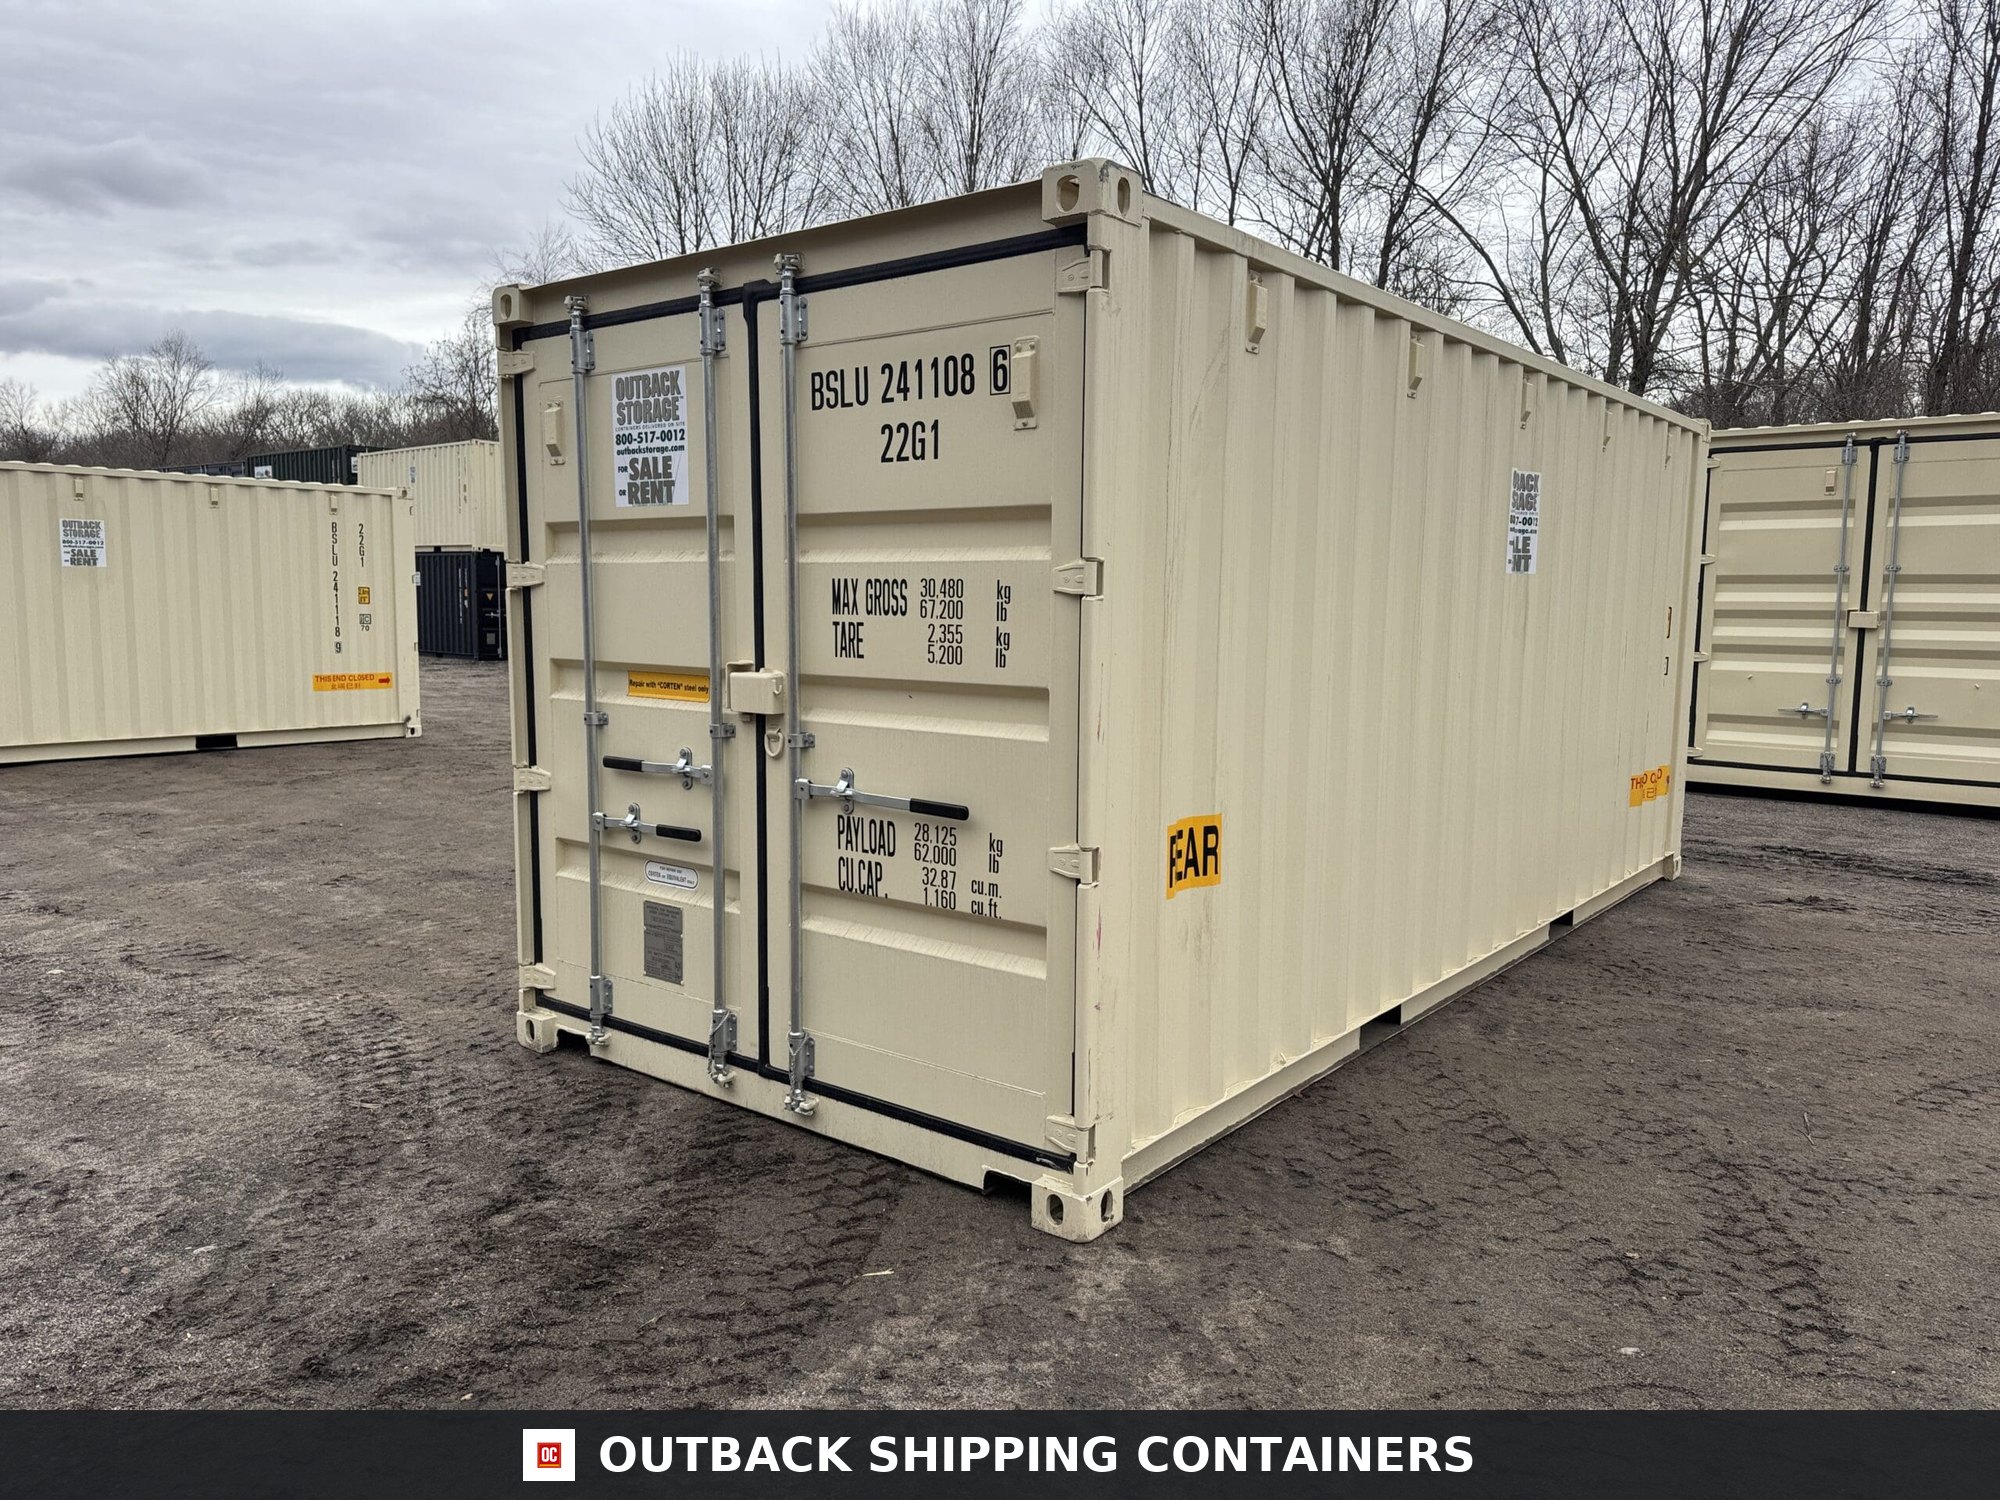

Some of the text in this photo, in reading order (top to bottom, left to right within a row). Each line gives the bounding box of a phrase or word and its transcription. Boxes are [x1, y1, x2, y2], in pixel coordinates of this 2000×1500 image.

[616, 370, 681, 401] OUTBACK
[811, 349, 1008, 411] BSLU 241108 6
[617, 398, 680, 426] STORAGE
[616, 428, 685, 446] 800-517-0012
[881, 419, 939, 463] 22G1
[616, 445, 685, 456] outbackstorage.com
[629, 455, 672, 481] SALE
[627, 479, 675, 505] RENT
[62, 520, 101, 530] OUTBACK
[63, 529, 101, 538] STORAGE
[70, 558, 98, 566] RENT
[71, 549, 96, 557] SALE
[333, 571, 341, 637] 241118
[832, 578, 859, 616] MAX
[865, 578, 908, 617] GROSS
[996, 579, 1011, 604] kg
[996, 601, 1007, 622] lb
[335, 642, 341, 653] 9
[832, 621, 864, 659] TARE
[996, 626, 1010, 650] kg
[995, 648, 1006, 668] lb
[315, 675, 331, 683] THIS
[629, 679, 645, 688] Repair
[684, 684, 696, 692] steel
[698, 685, 708, 694] only
[837, 814, 896, 857] PAYLOAD
[989, 832, 1003, 857] kg
[988, 854, 999, 874] lb
[922, 867, 956, 890] 32.87
[971, 879, 1002, 899] cu.m.
[971, 898, 1002, 919] cu.ft.
